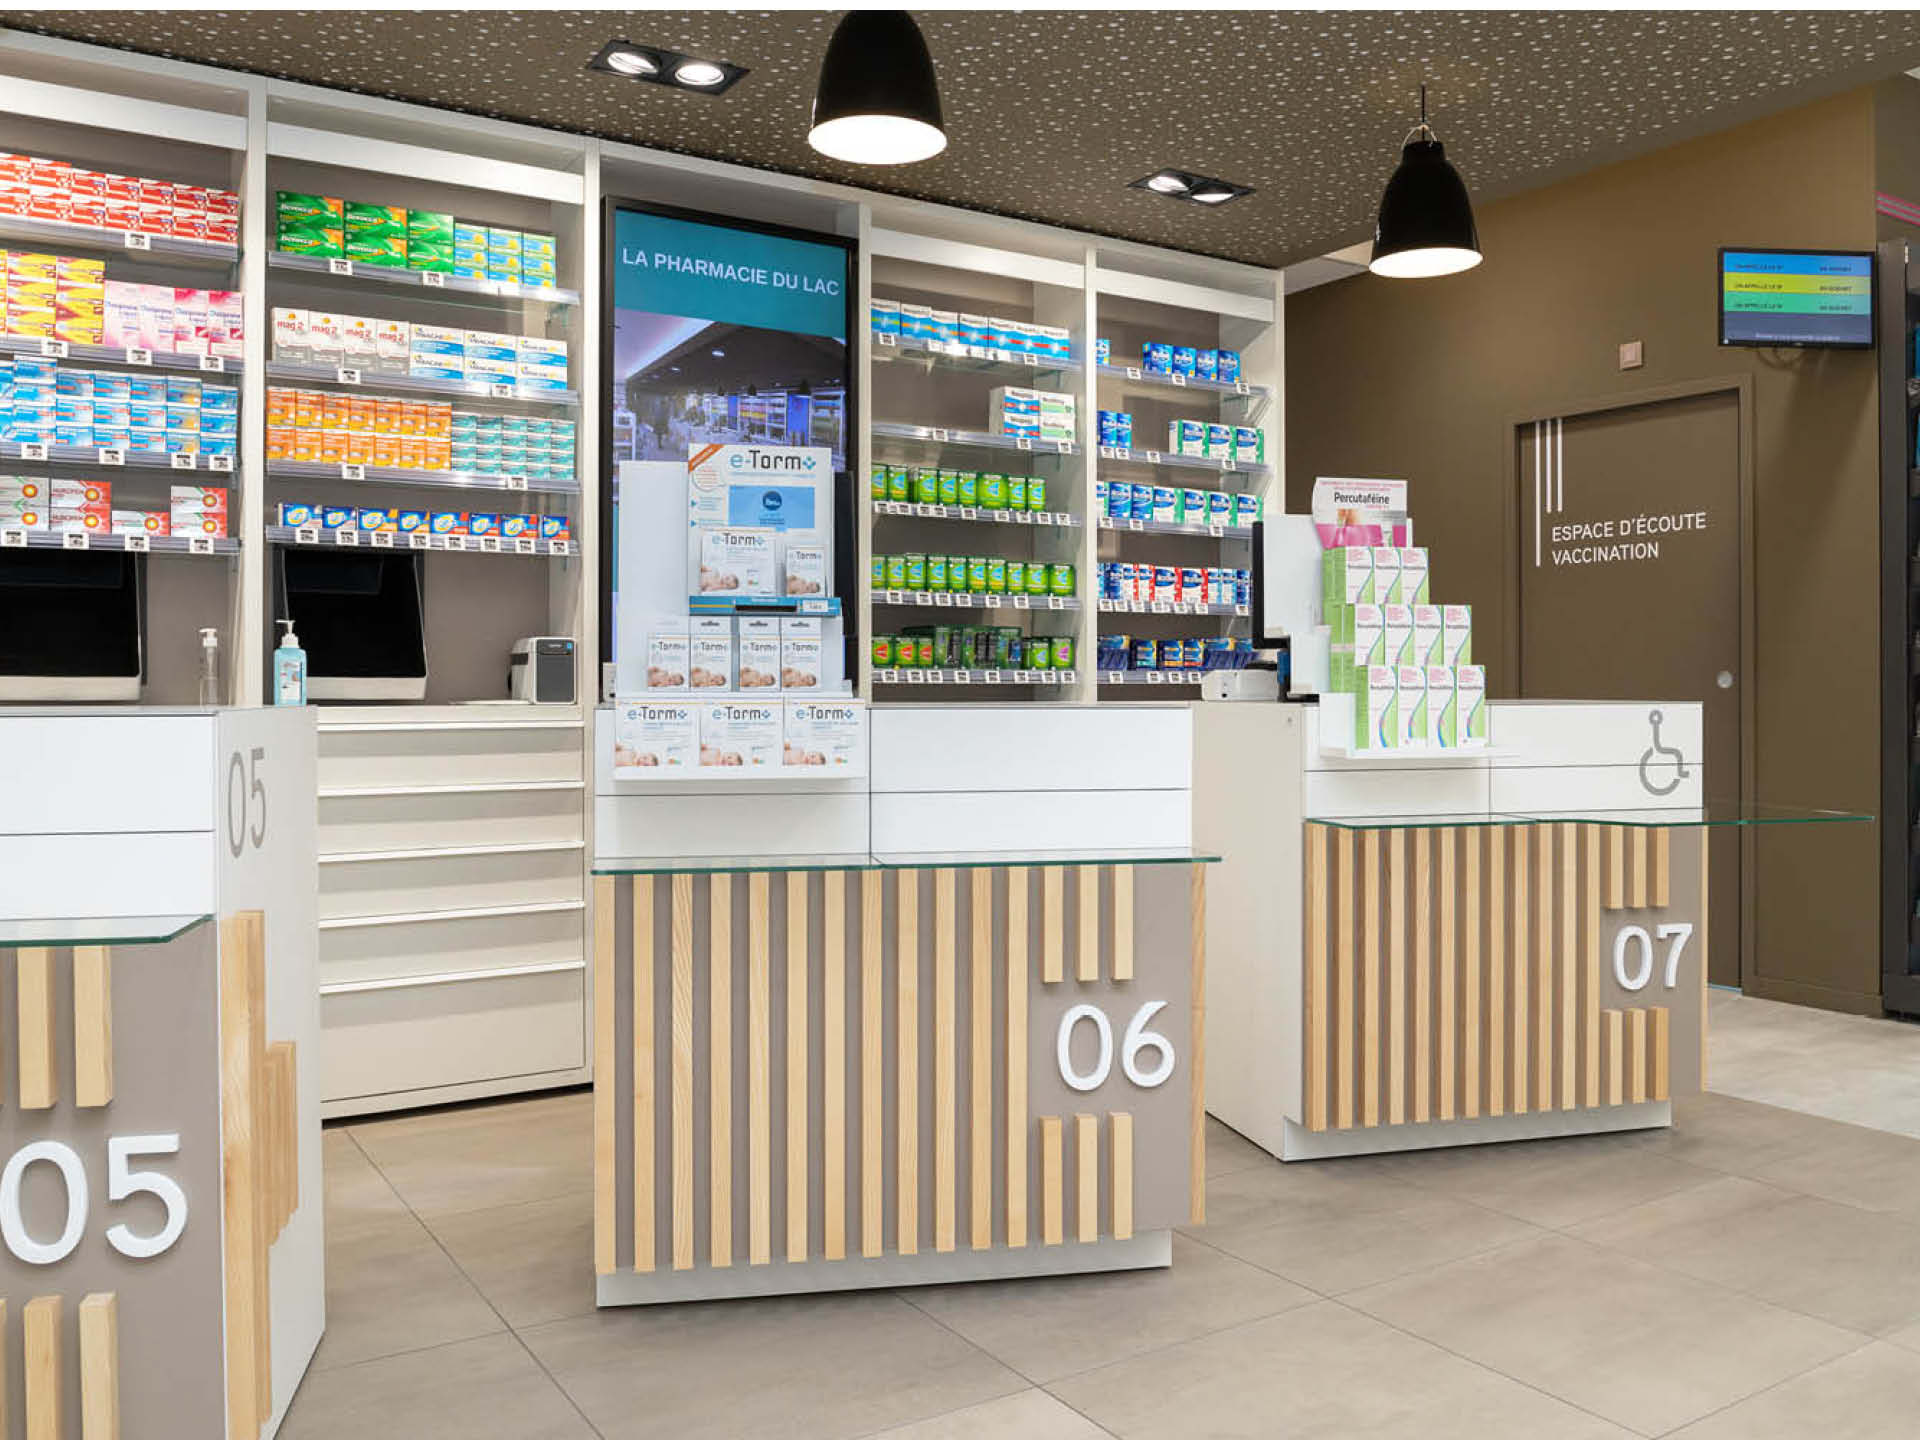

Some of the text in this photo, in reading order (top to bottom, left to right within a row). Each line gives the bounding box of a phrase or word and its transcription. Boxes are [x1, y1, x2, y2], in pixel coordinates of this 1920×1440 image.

[622, 248, 840, 296] LA PHARMACIE DU LAC
[1334, 492, 1390, 504] Percutaféine
[1552, 512, 1706, 542] ESPACE D'ÉCOUTE
[1552, 542, 1659, 566] VACCINATION
[228, 747, 266, 858] 05
[1613, 922, 1693, 991] 07
[1057, 1000, 1175, 1092] 06
[0, 1133, 188, 1265] 05
